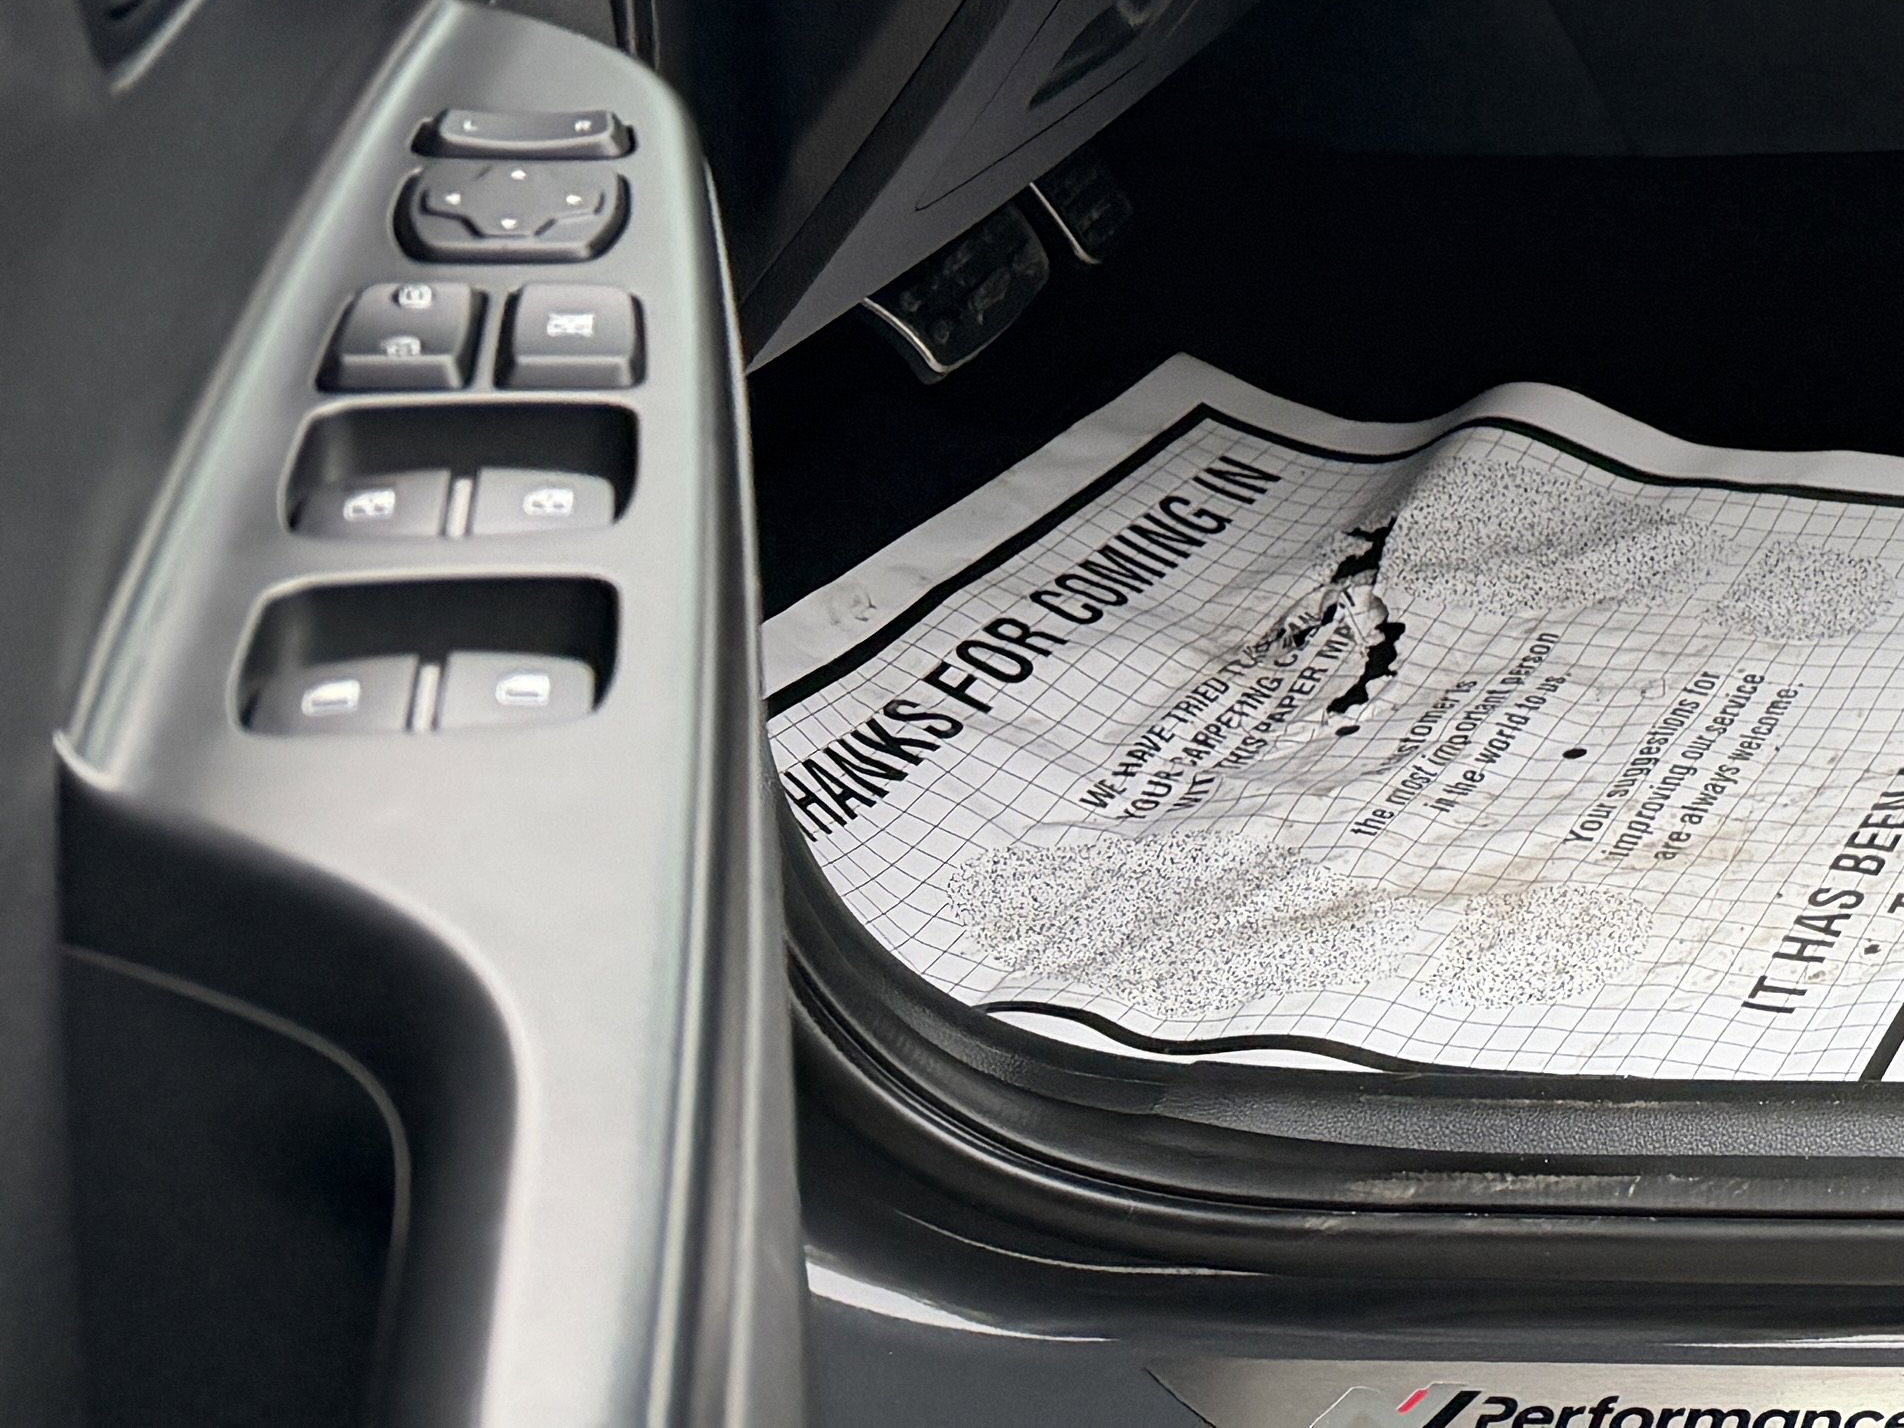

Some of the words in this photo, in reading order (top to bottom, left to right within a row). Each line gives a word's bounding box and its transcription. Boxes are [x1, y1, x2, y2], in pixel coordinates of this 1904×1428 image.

[784, 698, 964, 842] HANKS
[924, 616, 1067, 714] FOR
[1030, 495, 1233, 625] COMING
[1193, 455, 1281, 506] IN
[1079, 778, 1127, 809] WE
[1112, 725, 1176, 778] HAVE
[1166, 676, 1230, 724] TRIED
[1117, 756, 1184, 821] YOUR
[1181, 675, 1284, 768] CARPETING
[1214, 735, 1269, 770] THIS
[1258, 665, 1328, 739] PAPER
[1350, 806, 1395, 837] the
[1385, 764, 1438, 807] most
[1420, 687, 1512, 766] important
[1502, 631, 1560, 687] person
[1422, 794, 1456, 814] in
[1449, 768, 1486, 797] the
[1480, 710, 1529, 766] world
[1517, 693, 1547, 712] to
[1564, 791, 1618, 846] Your
[1608, 697, 1700, 800] suggestions
[1687, 670, 1722, 697] for
[1602, 761, 1697, 858] improving
[1681, 730, 1716, 765] our
[1705, 671, 1766, 736] service
[1654, 826, 1691, 862] are
[1679, 763, 1742, 826] always
[1772, 887, 1864, 963] HAS
[1741, 975, 1808, 1014] IT
